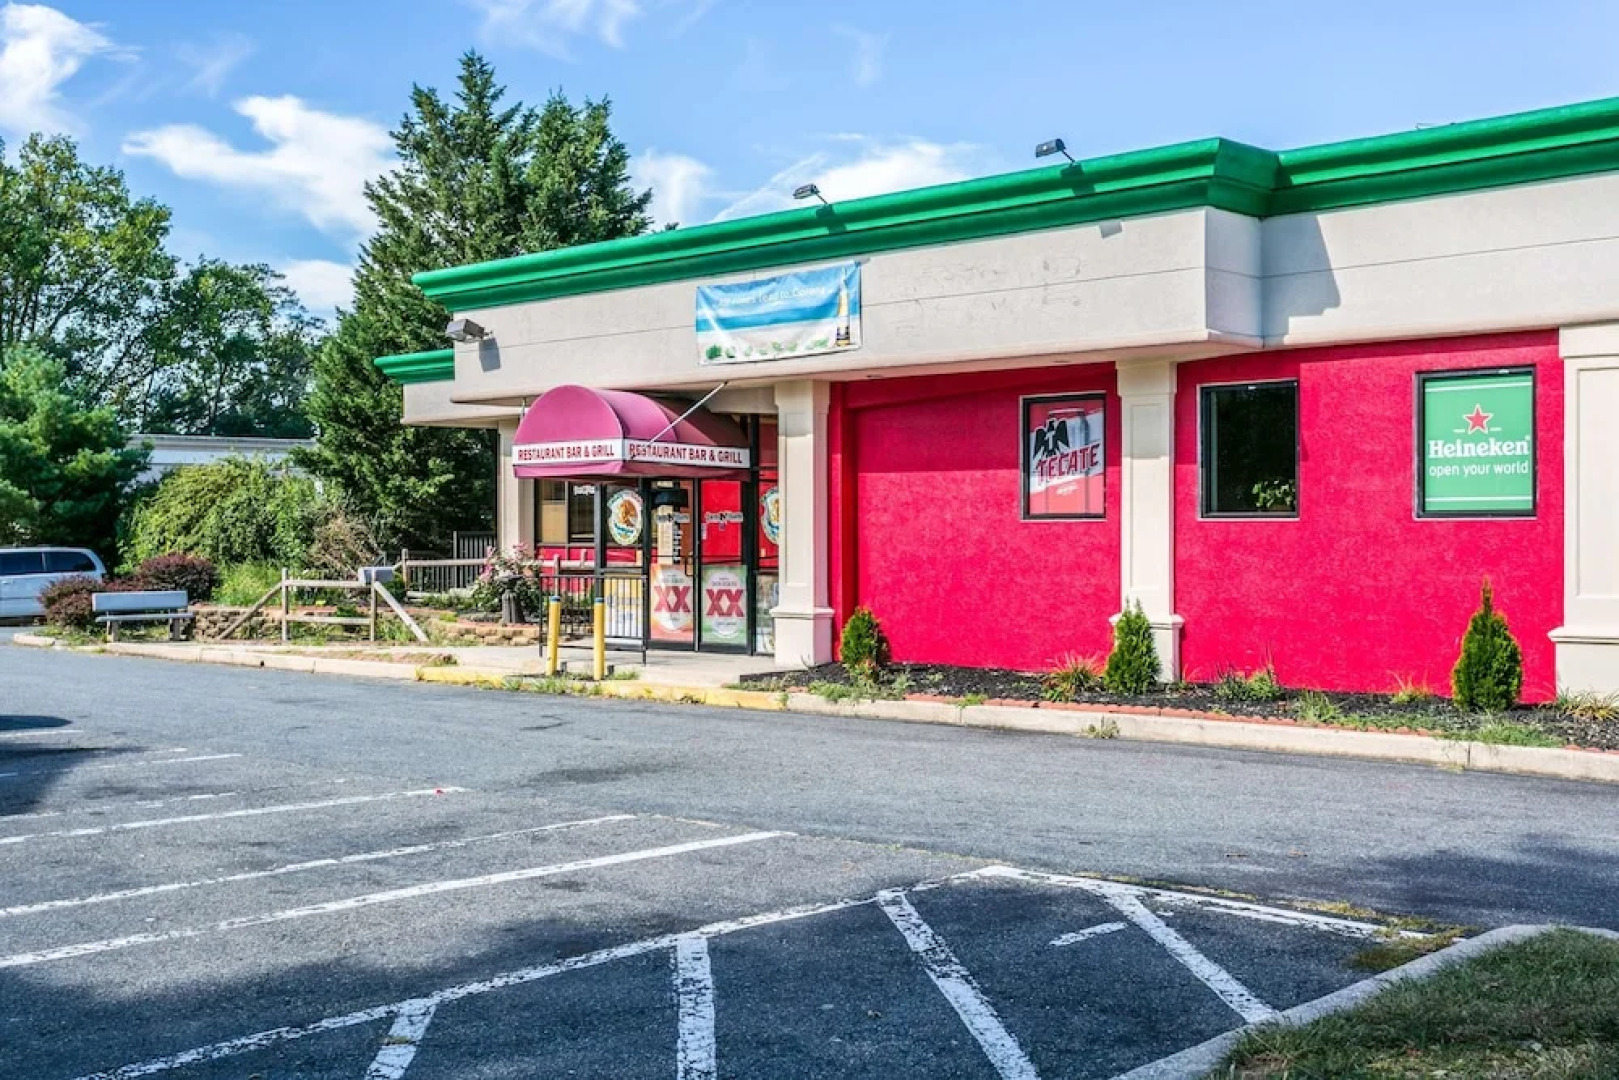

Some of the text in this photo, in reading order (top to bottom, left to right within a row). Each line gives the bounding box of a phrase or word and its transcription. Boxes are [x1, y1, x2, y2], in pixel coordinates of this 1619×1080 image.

[518, 444, 615, 460] RESTAURANT BAR & GRILL
[629, 443, 743, 464] RESTAURANT BAR & GRILL
[1428, 438, 1529, 458] Heineken
[1036, 443, 1100, 483] TECATE
[1429, 461, 1529, 478] open your world
[654, 586, 691, 612] XX
[706, 589, 744, 617] XX
